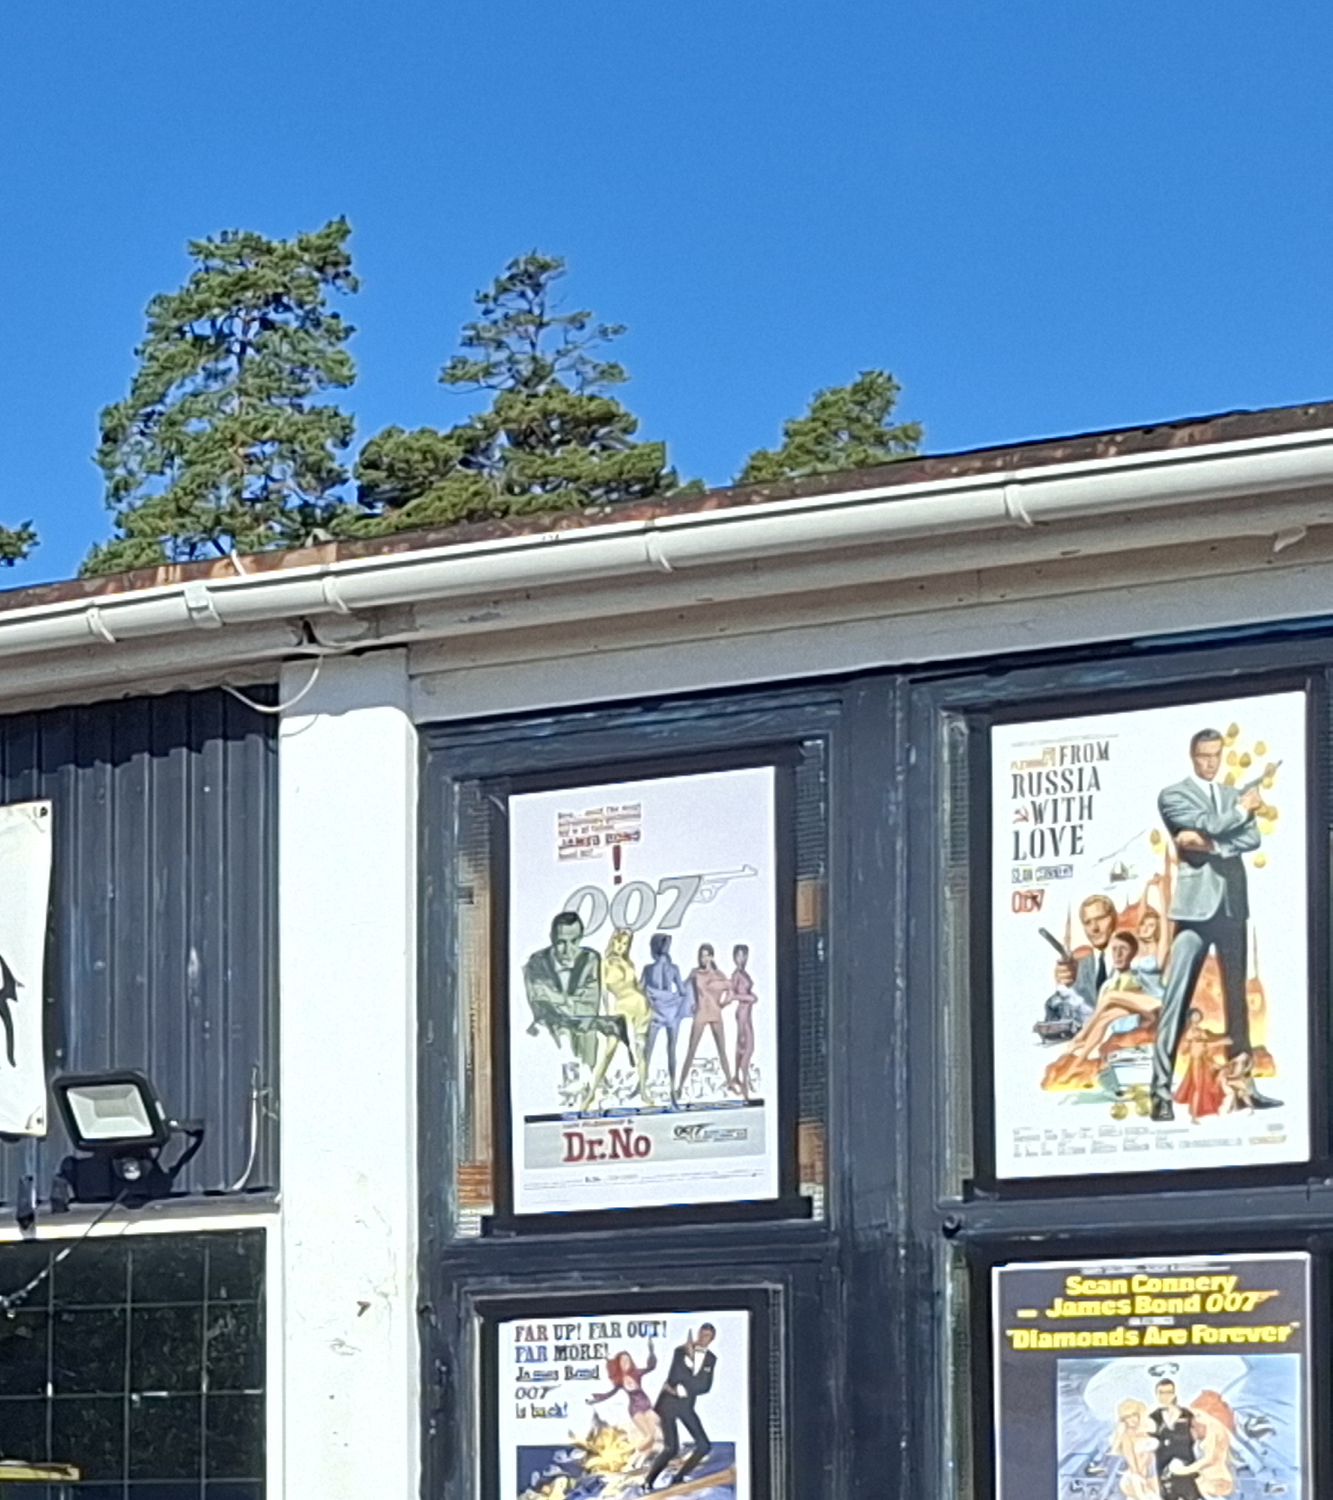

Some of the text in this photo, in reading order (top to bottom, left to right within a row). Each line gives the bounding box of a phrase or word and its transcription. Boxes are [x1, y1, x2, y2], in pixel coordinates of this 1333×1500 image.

[1059, 741, 1110, 767] FROM
[1011, 765, 1101, 800] RUSSIA
[1030, 795, 1093, 826] WITH
[1012, 824, 1084, 861] LOVE
[562, 875, 703, 937] 007
[1065, 1274, 1238, 1297] Sean Connery
[1045, 1297, 1131, 1318] James
[1134, 1294, 1201, 1315] Bond
[1205, 1291, 1260, 1312] 007
[514, 1320, 668, 1342] FAR UP! FAR OUT!
[1143, 1324, 1188, 1346] Are
[515, 1342, 609, 1363] FAR MORE!
